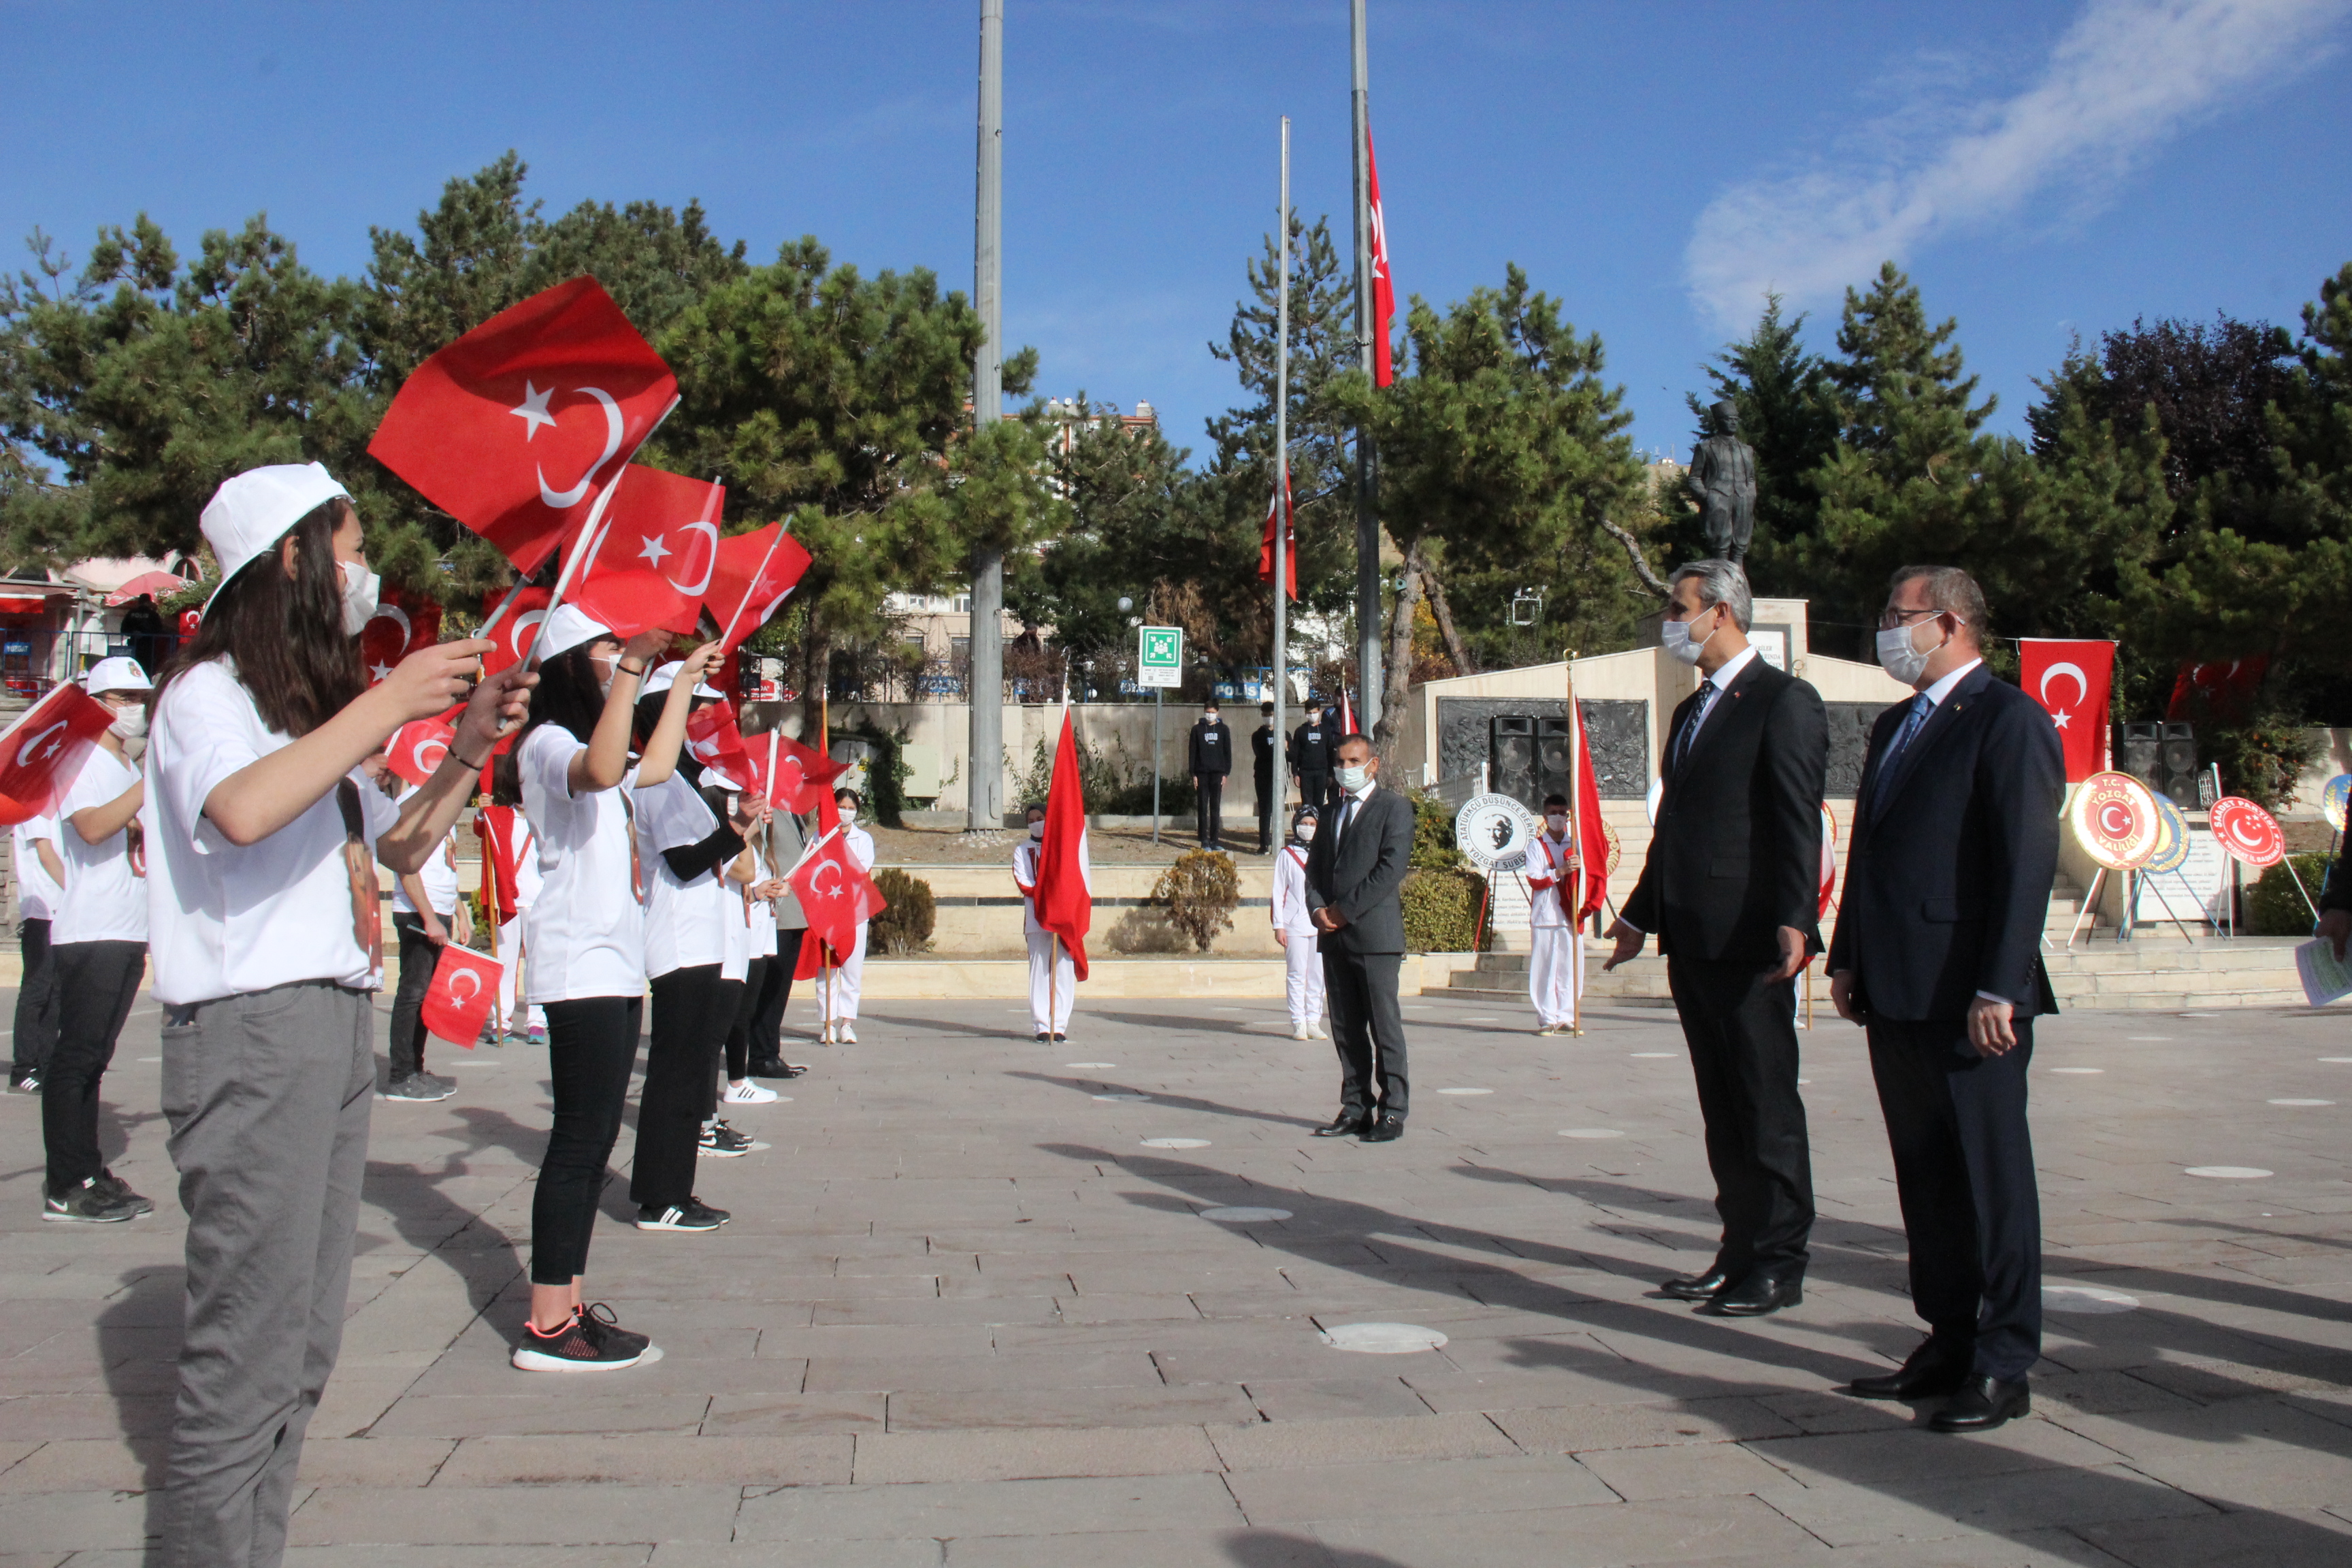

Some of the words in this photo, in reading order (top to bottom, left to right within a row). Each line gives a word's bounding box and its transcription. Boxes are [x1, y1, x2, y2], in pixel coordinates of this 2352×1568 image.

[2102, 779, 2121, 787] T.C.
[2091, 789, 2136, 806] YOZGAT
[1460, 800, 1482, 840] ATATÜRKÇÜ
[1482, 796, 1522, 813] DÜŞÜNCE
[2213, 800, 2235, 828] SAADET
[1469, 847, 1499, 868] YOZGAT
[2224, 840, 2249, 859] YOZGAT
